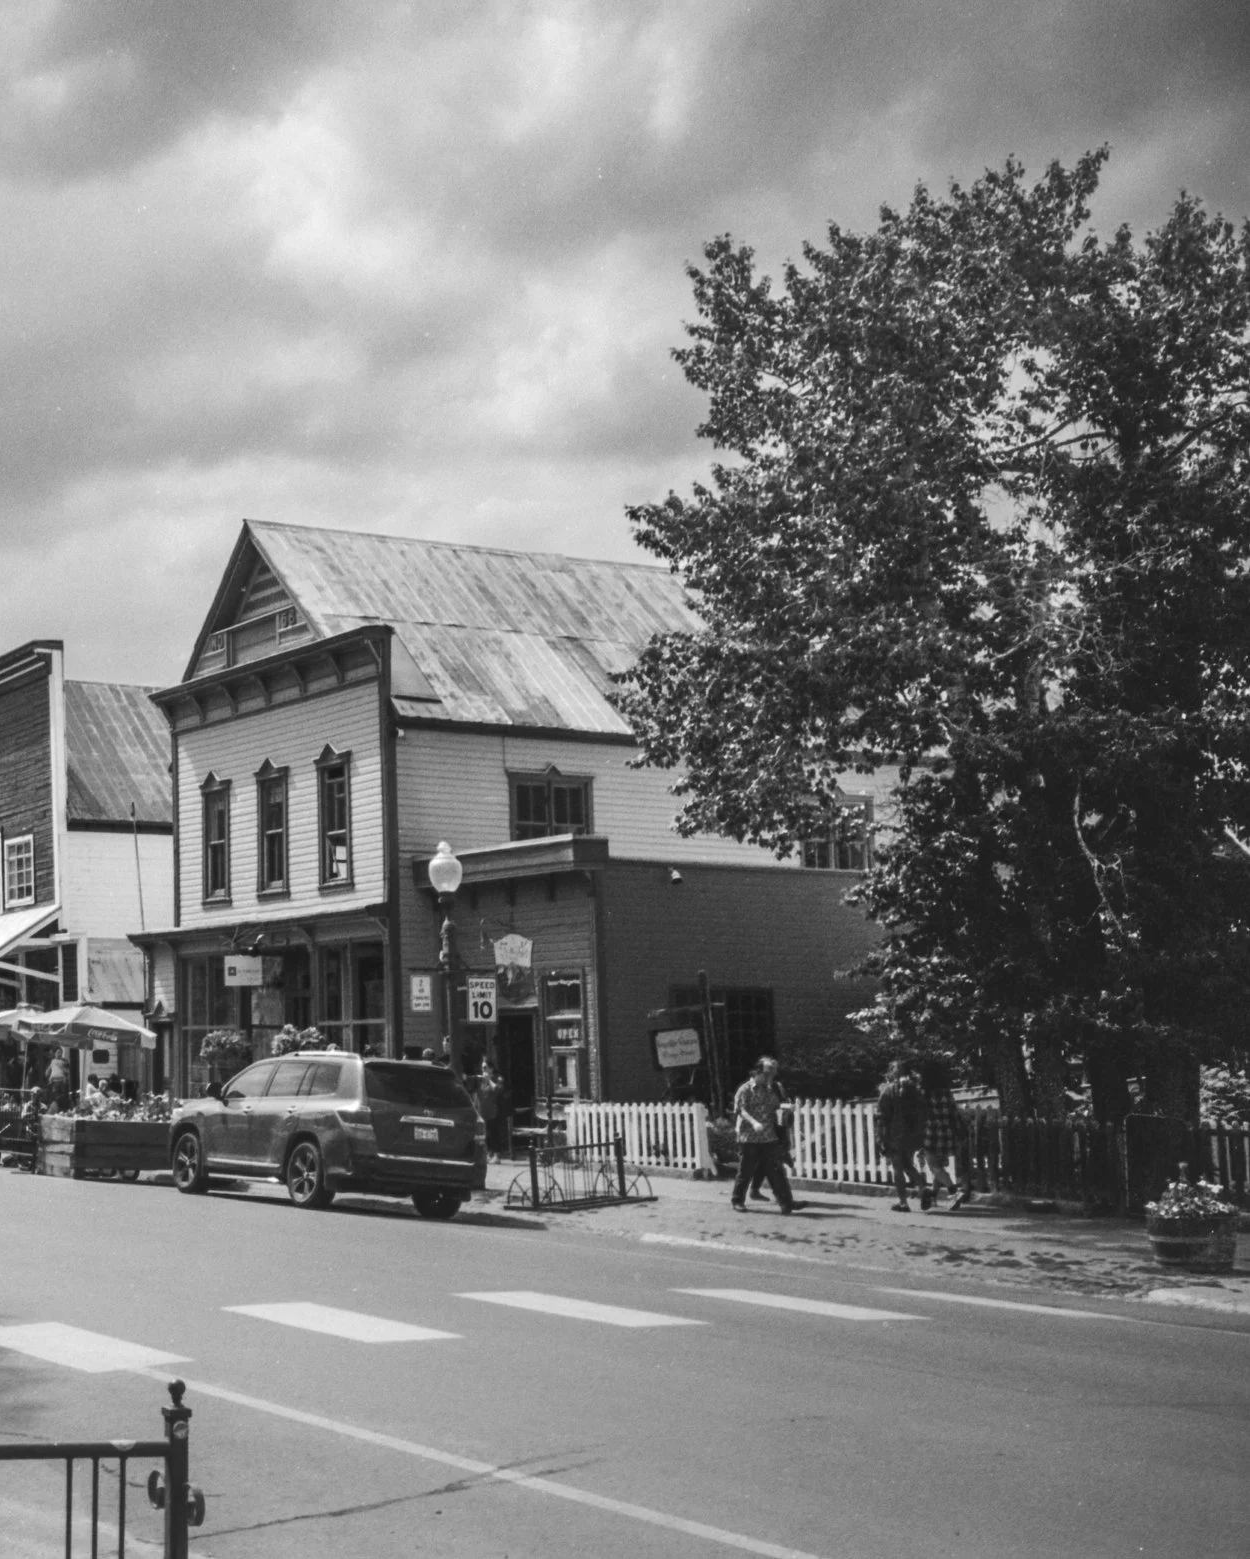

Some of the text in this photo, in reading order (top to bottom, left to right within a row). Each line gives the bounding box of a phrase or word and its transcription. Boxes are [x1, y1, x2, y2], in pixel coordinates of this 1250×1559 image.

[469, 981, 495, 989] SPEED
[471, 991, 492, 999] LIMIT
[472, 1001, 493, 1019] 10
[557, 1028, 579, 1040] OPEN
